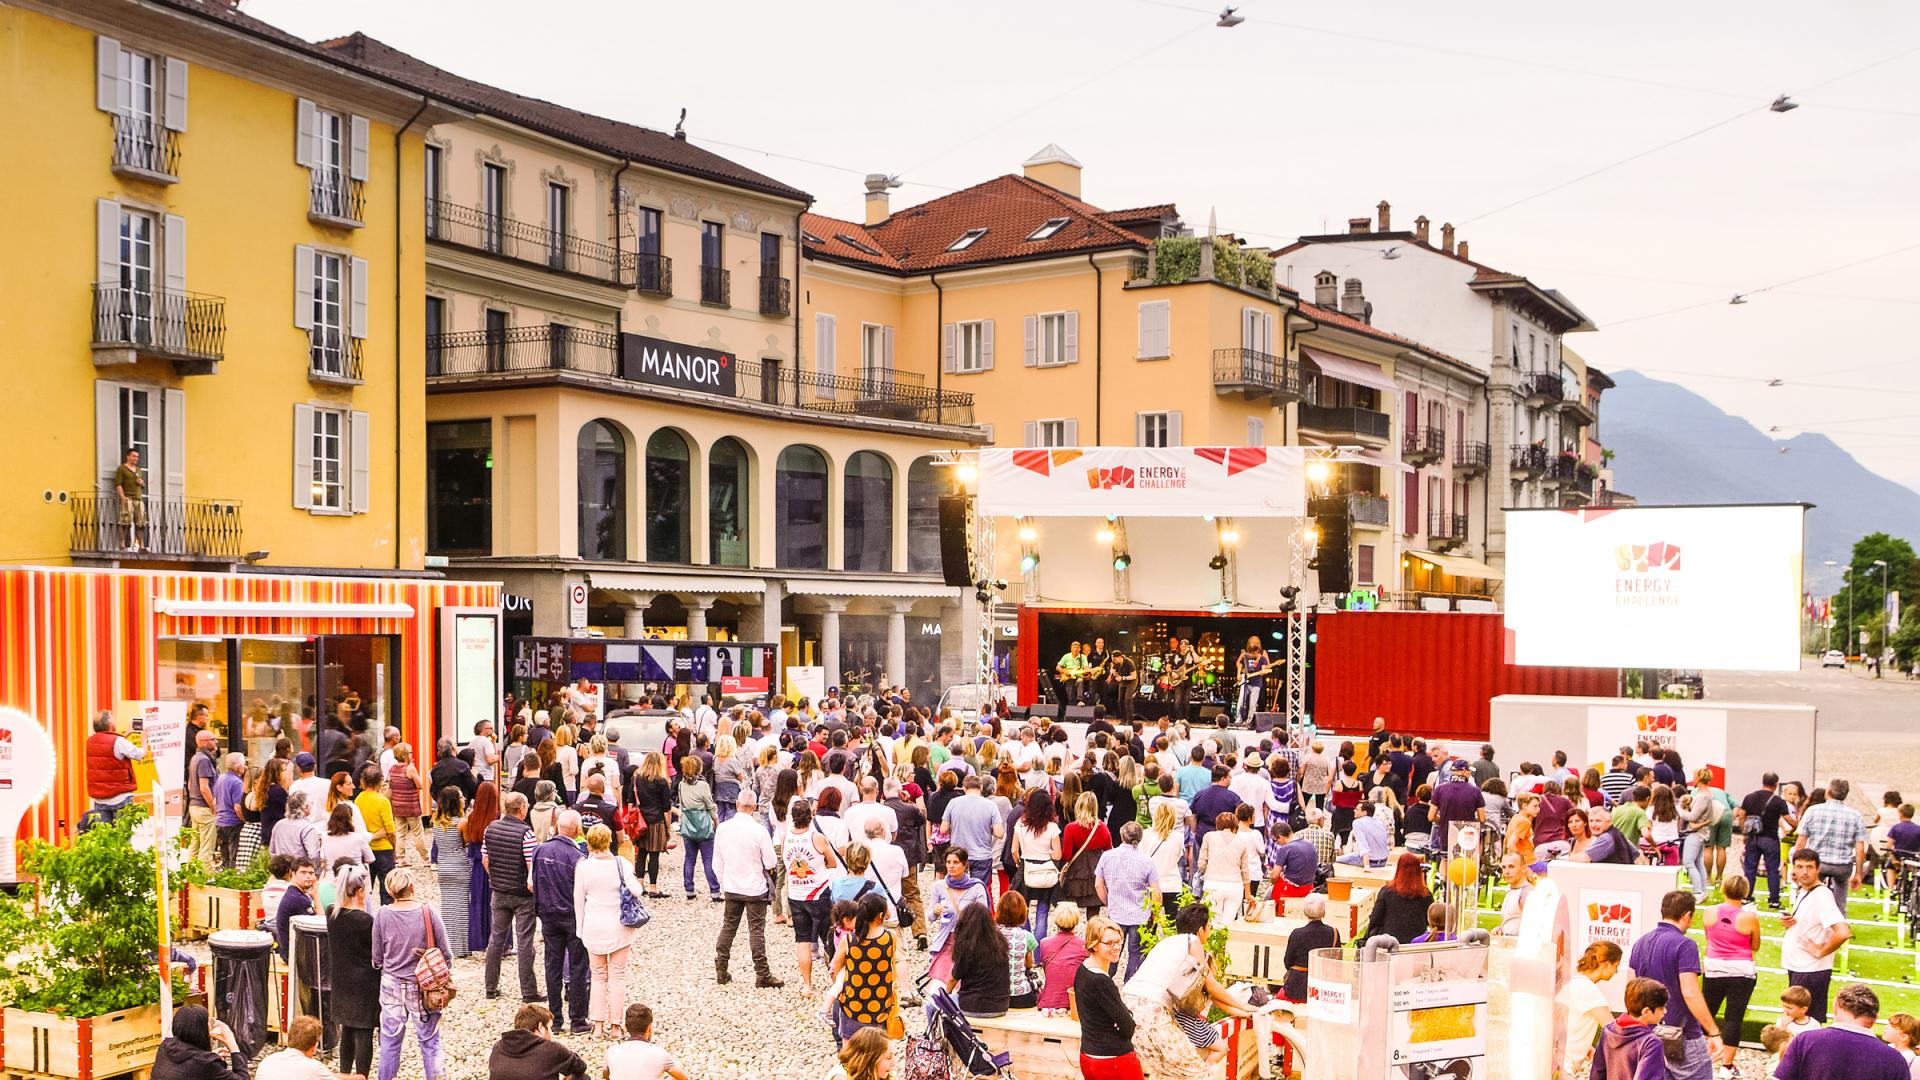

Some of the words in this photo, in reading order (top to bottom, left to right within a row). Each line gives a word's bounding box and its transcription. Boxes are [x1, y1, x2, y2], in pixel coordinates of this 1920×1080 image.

[641, 346, 720, 386] MANOR
[1139, 467, 1180, 479] ENERGY
[1139, 479, 1187, 489] CHALLENGE
[1615, 578, 1671, 593] ENERGY
[1588, 925, 1626, 937] ENERGY
[1320, 989, 1342, 998] ENERGY
[1393, 1049, 1400, 1060] 8
